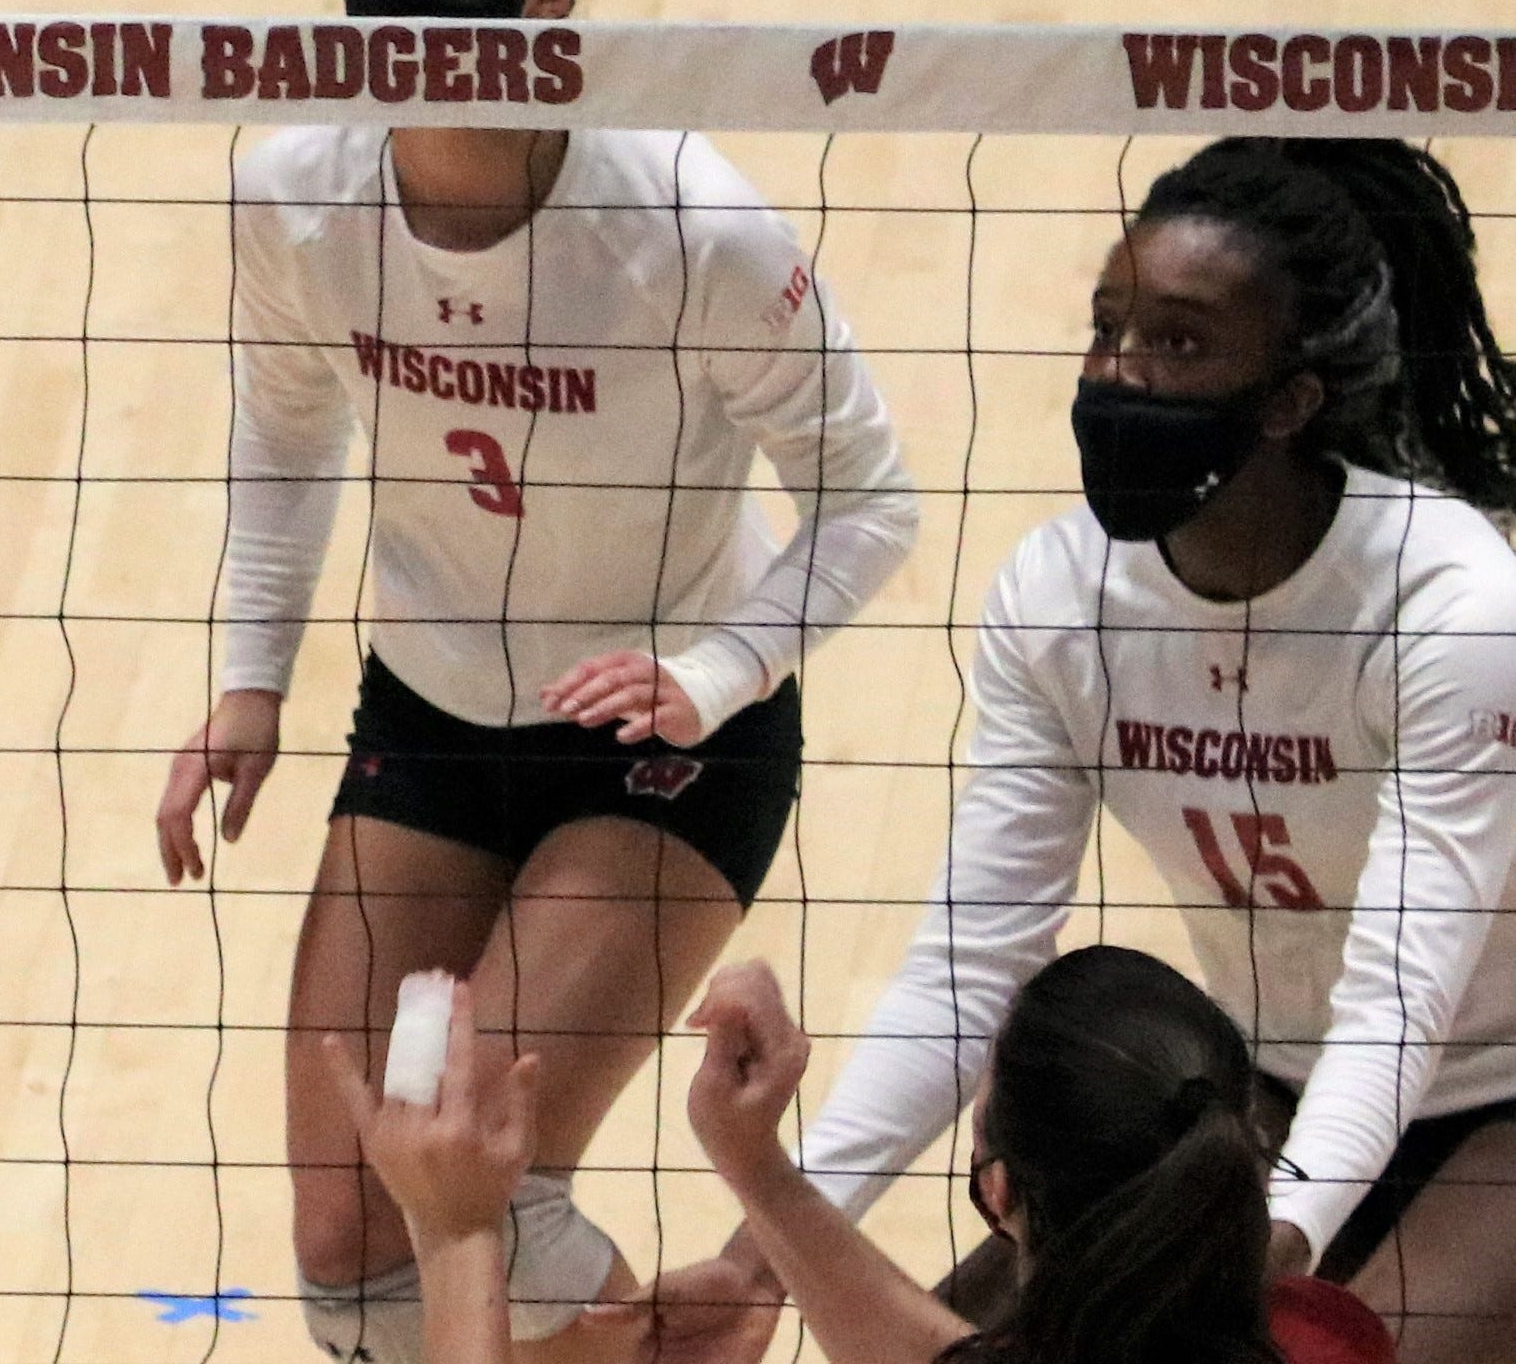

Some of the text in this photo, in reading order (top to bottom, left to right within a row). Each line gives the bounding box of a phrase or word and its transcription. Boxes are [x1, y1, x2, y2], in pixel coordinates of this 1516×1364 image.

[200, 23, 584, 105] BADGERS
[350, 329, 597, 414] WISCONSIN
[444, 427, 525, 518] 3
[1115, 718, 1338, 785] WISCONSIN
[1181, 806, 1325, 911] 15
